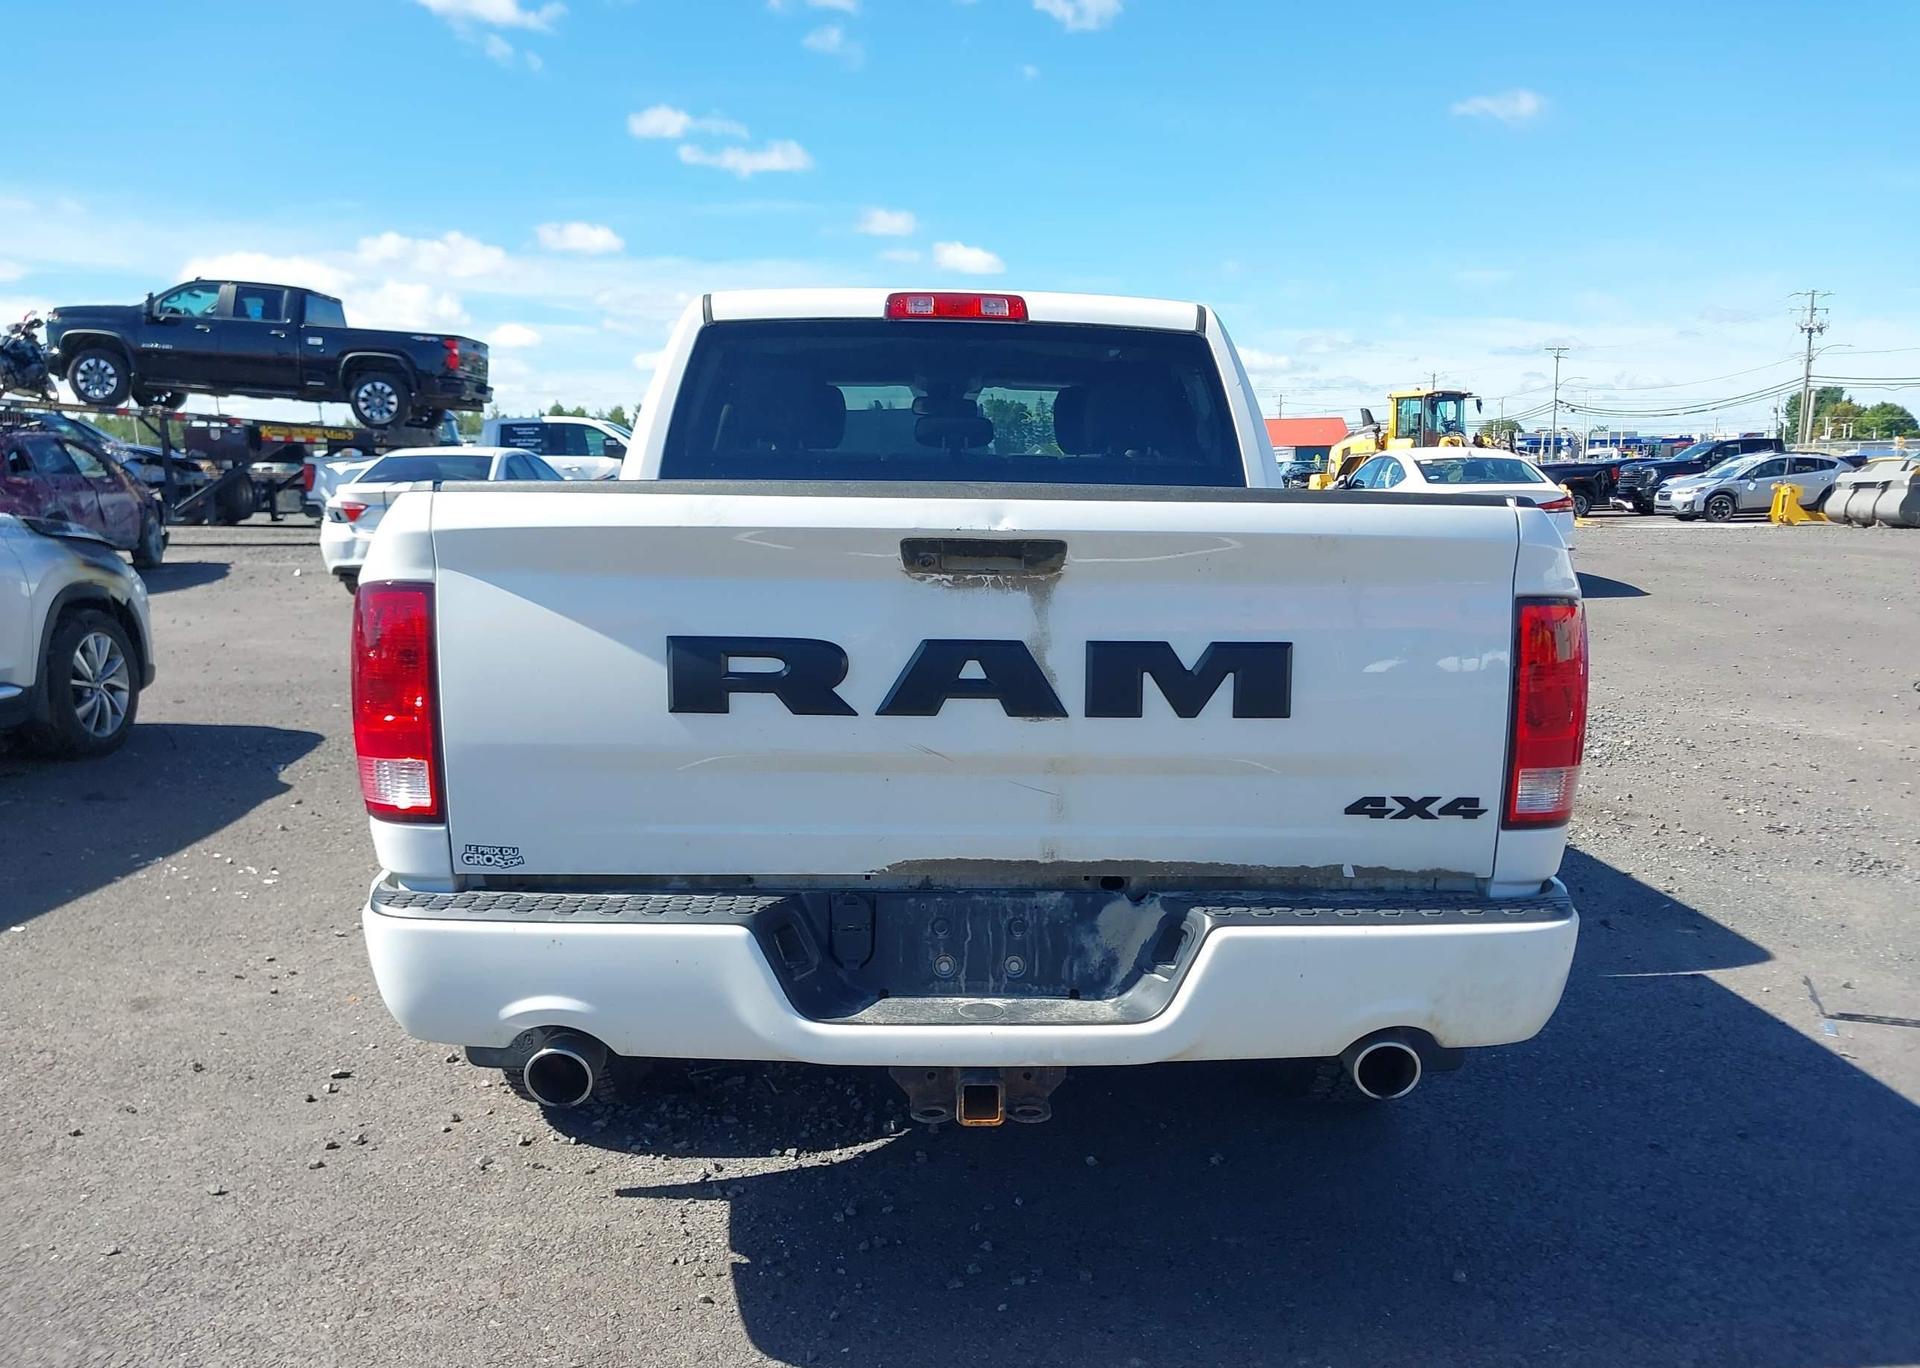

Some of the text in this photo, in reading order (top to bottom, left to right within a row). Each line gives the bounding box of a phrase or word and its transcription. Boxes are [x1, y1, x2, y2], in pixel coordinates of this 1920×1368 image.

[666, 635, 1293, 718] RAM
[466, 845, 477, 853] LE
[478, 846, 501, 855] PRIX
[462, 853, 504, 866] GROS
